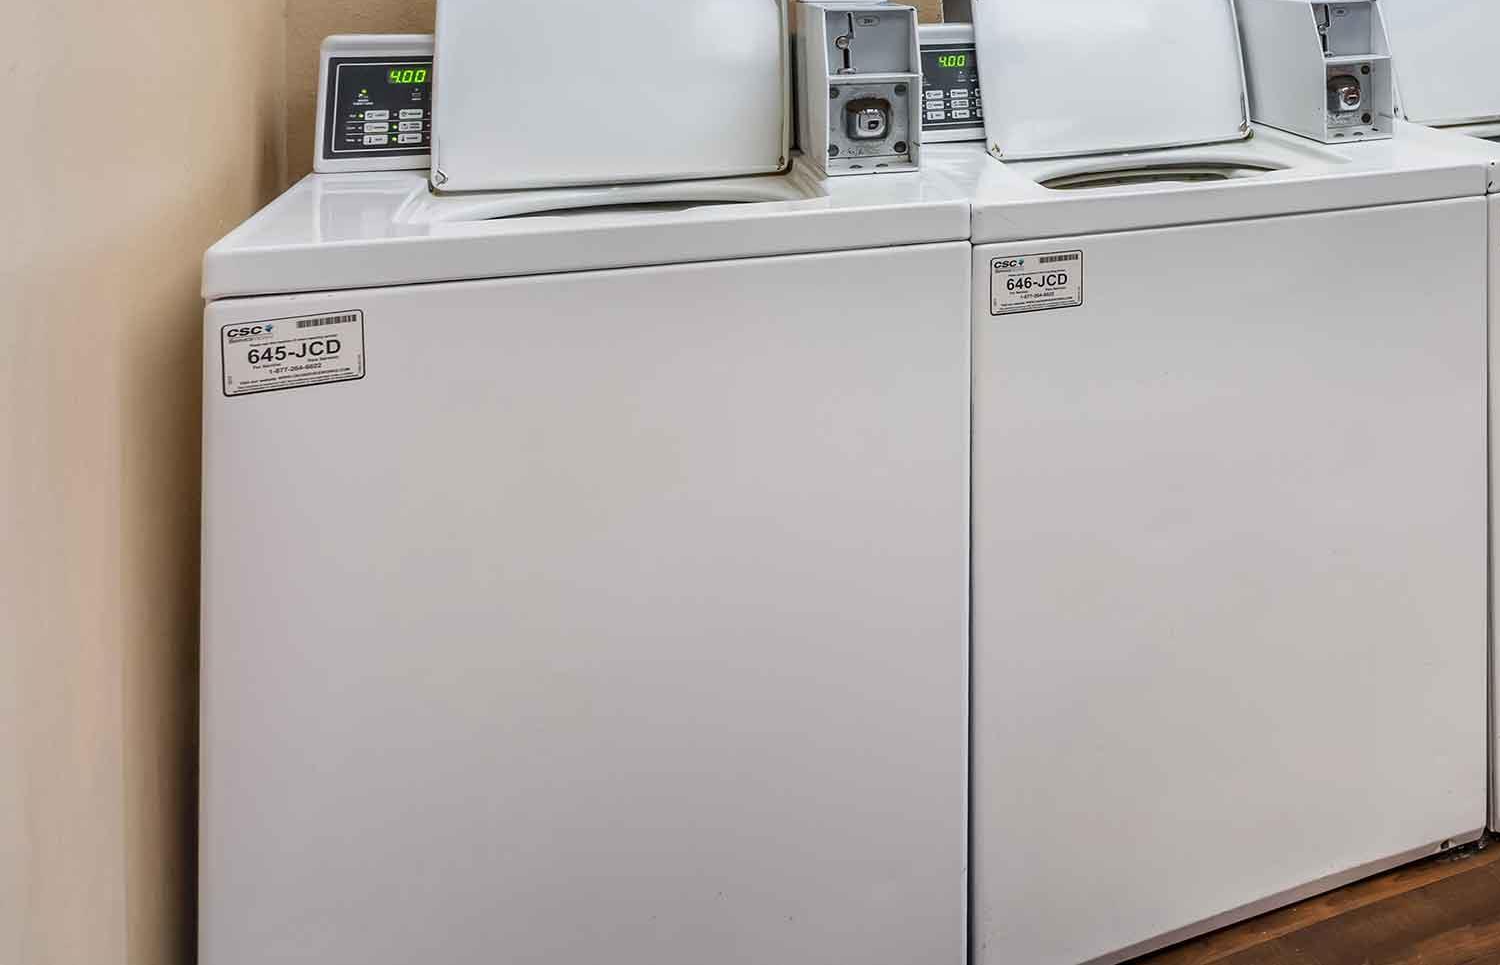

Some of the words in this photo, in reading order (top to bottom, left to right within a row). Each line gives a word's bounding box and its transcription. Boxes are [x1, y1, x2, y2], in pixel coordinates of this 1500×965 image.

[993, 260, 1017, 269] CSC
[1006, 273, 1068, 291] 646-JCD
[227, 326, 263, 338] CSC
[248, 339, 341, 364] 645-JCD
